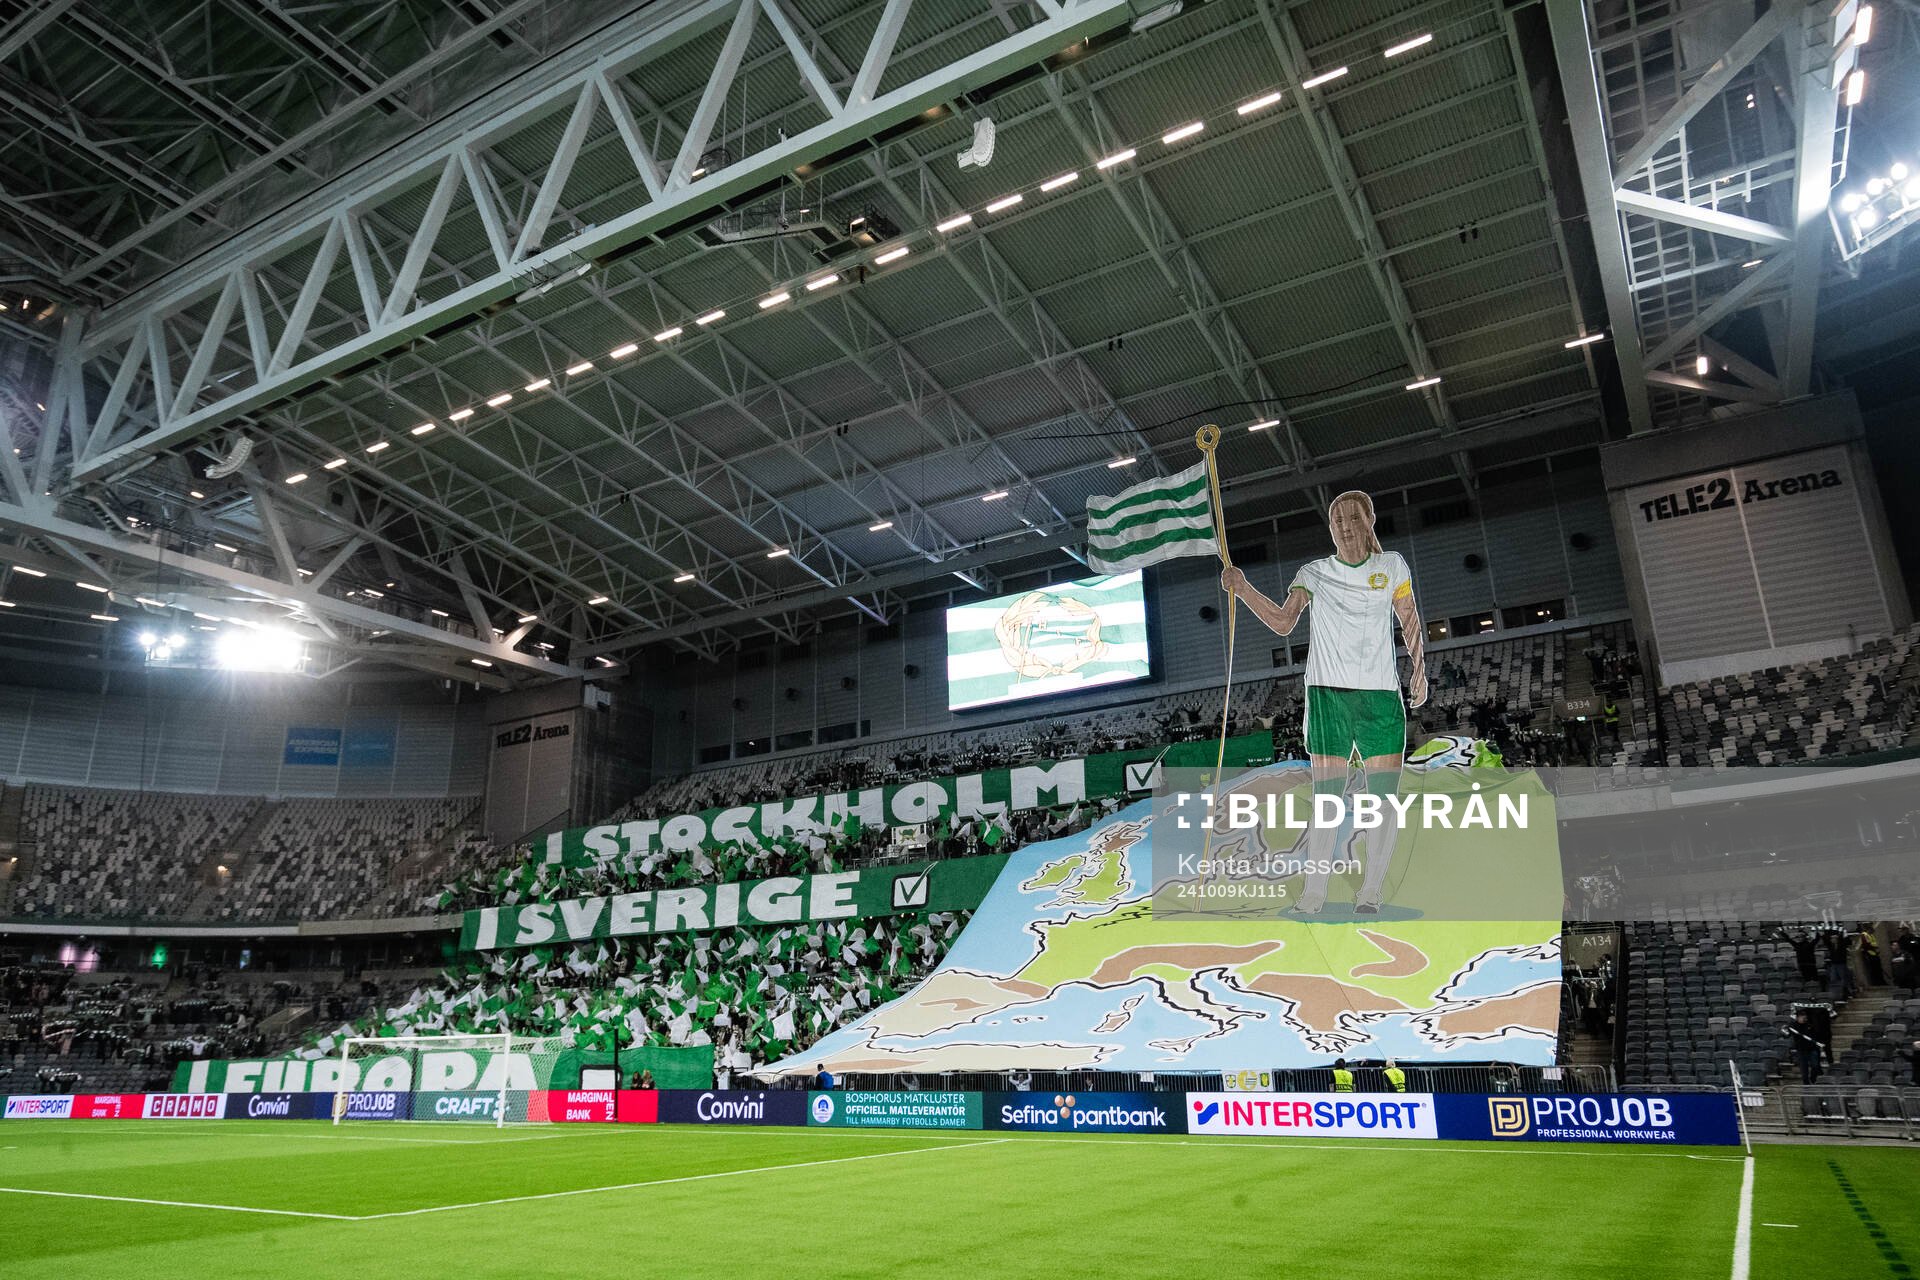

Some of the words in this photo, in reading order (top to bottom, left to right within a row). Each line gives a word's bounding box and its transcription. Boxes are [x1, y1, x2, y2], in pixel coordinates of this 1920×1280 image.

[1640, 478, 1735, 522] TELE2
[1743, 469, 1842, 504] Arena
[497, 724, 532, 748] TELE2
[534, 724, 569, 741] Arena
[546, 832, 562, 864] I
[583, 759, 1086, 862] STOCKHOLM
[475, 907, 499, 950] I
[515, 870, 860, 945] SVERIGE
[1582, 935, 1612, 947] A134
[188, 1060, 211, 1093] I
[15, 1099, 70, 1114] INTERSPORT
[152, 1099, 216, 1113] CRAMO
[248, 1095, 291, 1117] Convini
[347, 1093, 396, 1111] PROJOB
[435, 1097, 494, 1115] CRAFT
[567, 1092, 614, 1104] MARGINAL
[697, 1092, 765, 1121] Convini
[845, 1093, 902, 1103] BOSPHORUS
[904, 1094, 965, 1104] MATKLUSTER
[566, 1109, 591, 1120] BANK
[845, 1105, 887, 1115] OFFICIELL
[889, 1104, 966, 1116] MATLEVERANTÖR
[1001, 1105, 1057, 1124] Sefina
[1073, 1106, 1166, 1128] pantbank
[1223, 1100, 1420, 1129] INTERSPORT
[1532, 1097, 1673, 1127] PROJOB
[845, 1117, 859, 1125] TILL
[861, 1117, 900, 1125] HAMMARBY
[902, 1117, 938, 1126] FOTBOLLS
[940, 1118, 966, 1126] DAMER
[1537, 1128, 1613, 1138] PROFESSIONAL
[1614, 1129, 1675, 1140] WORKWEAR
